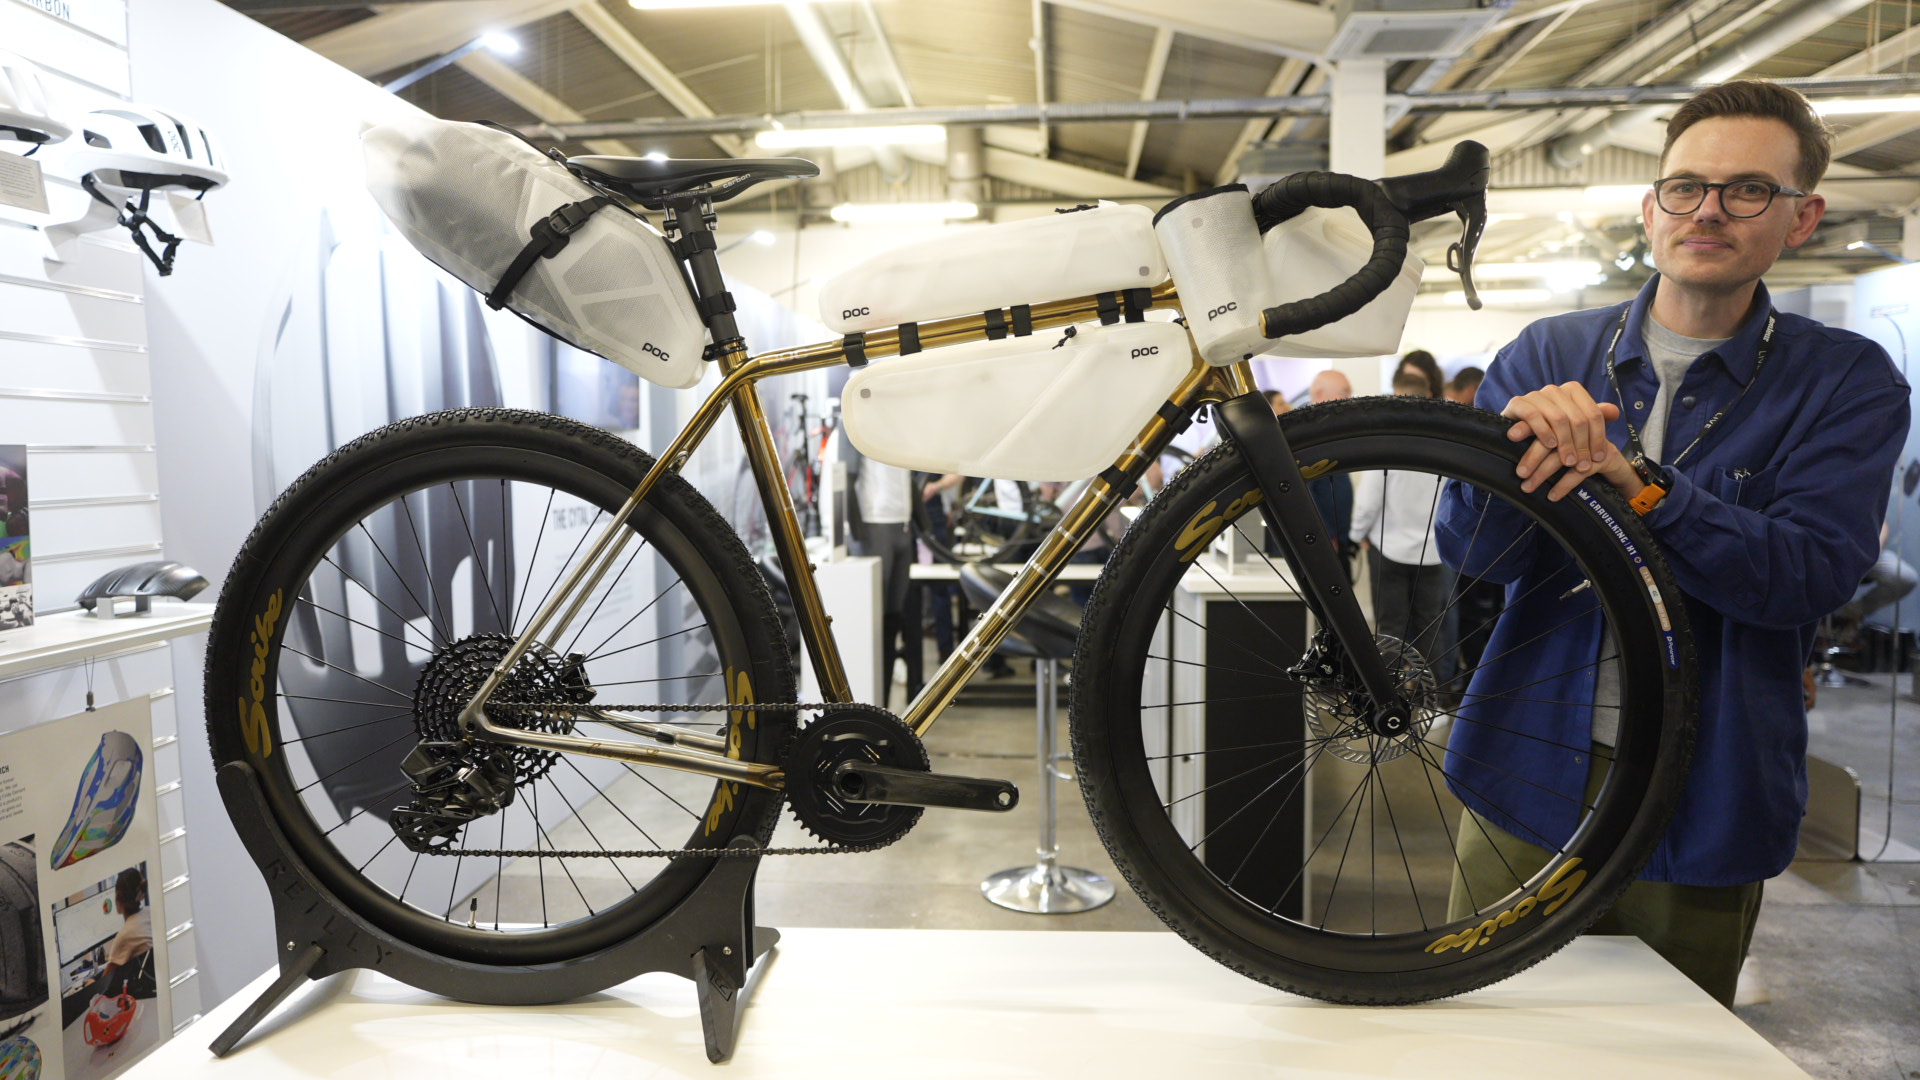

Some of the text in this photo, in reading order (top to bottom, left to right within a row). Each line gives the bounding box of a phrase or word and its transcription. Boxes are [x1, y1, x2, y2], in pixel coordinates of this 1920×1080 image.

[723, 173, 751, 189] carbon
[842, 307, 870, 320] poc
[1208, 302, 1237, 321] poc
[641, 342, 670, 362] poc
[1131, 346, 1159, 359] poc
[1704, 412, 1723, 430] LIVE
[1588, 500, 1629, 544] GRAVELKING
[238, 587, 283, 759] Scribe
[264, 858, 393, 965] REILLY
[1424, 857, 1588, 954] Scribe
